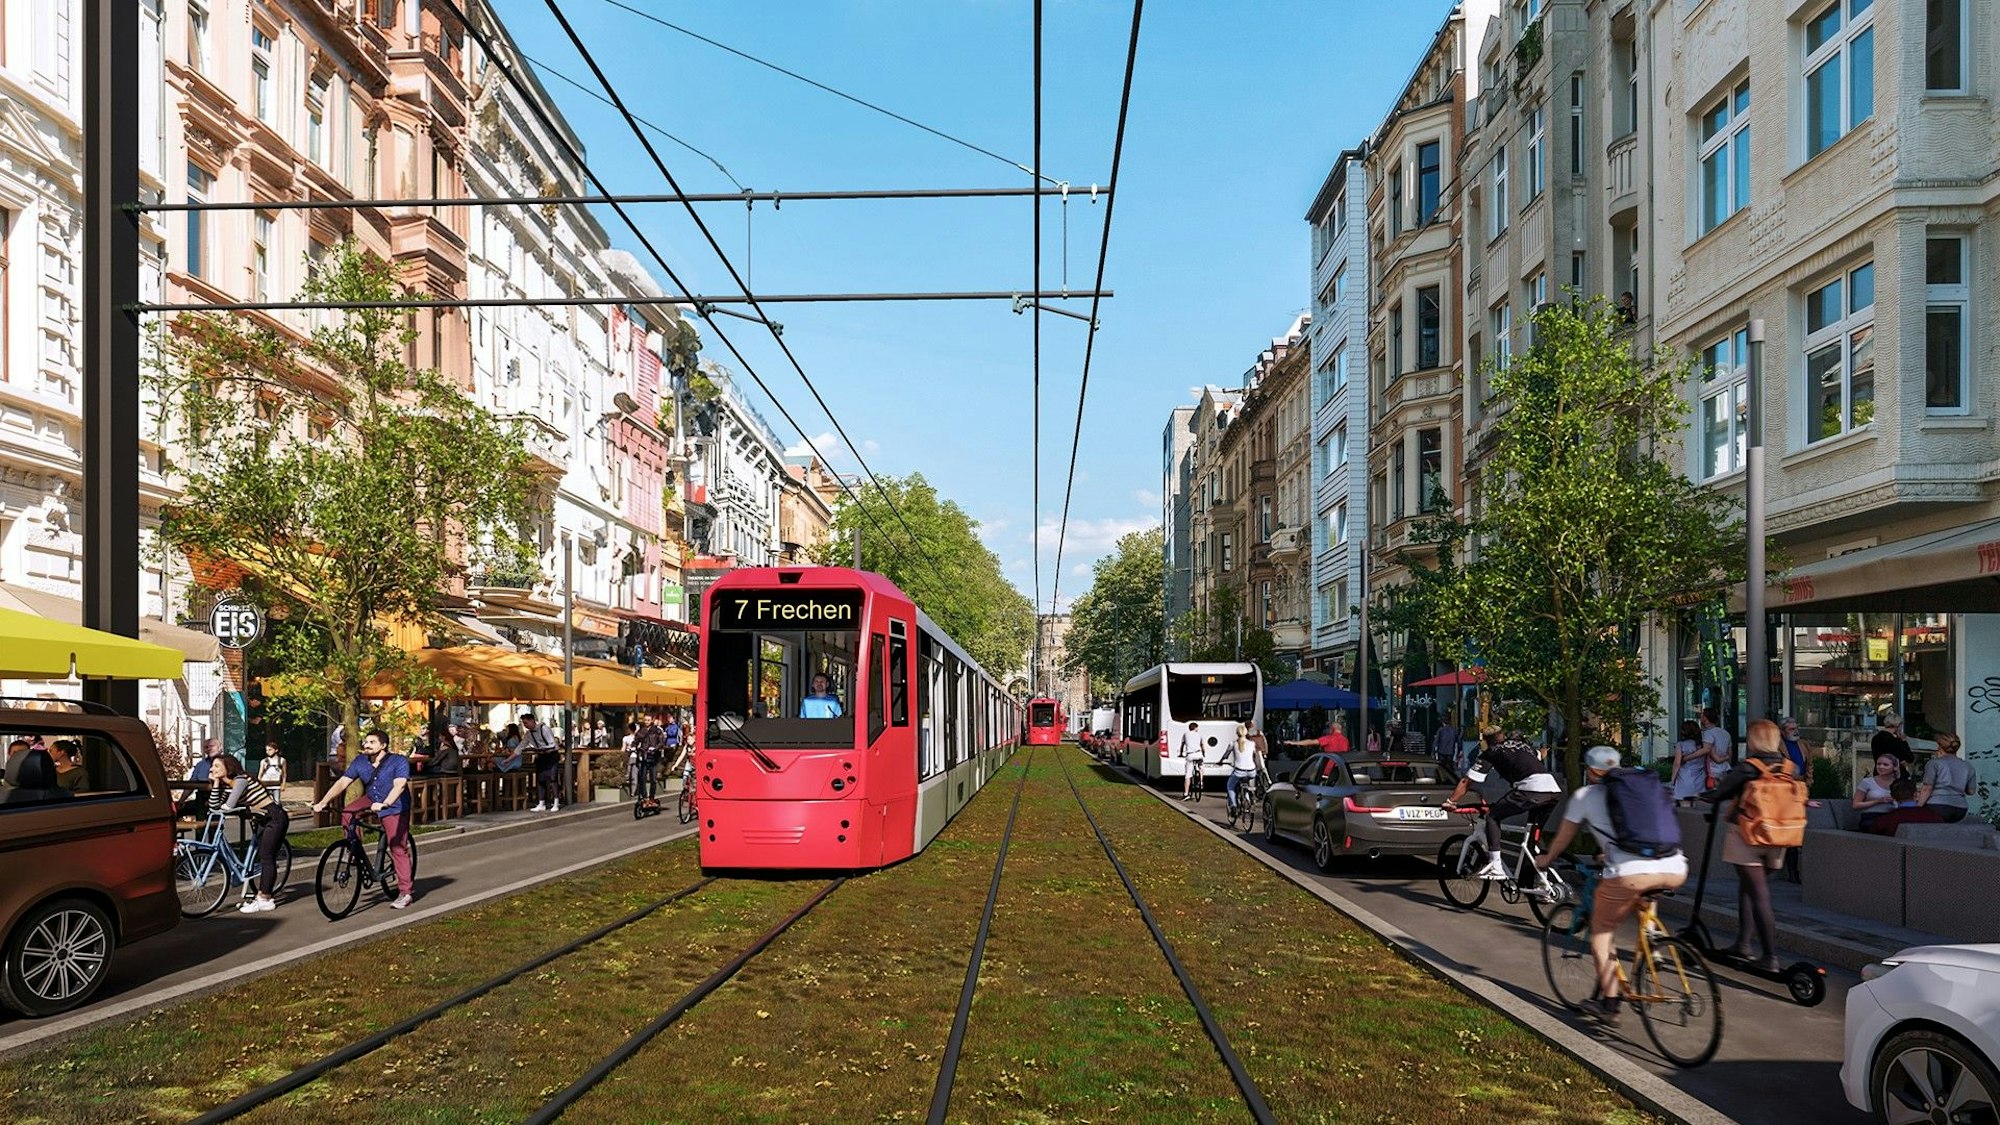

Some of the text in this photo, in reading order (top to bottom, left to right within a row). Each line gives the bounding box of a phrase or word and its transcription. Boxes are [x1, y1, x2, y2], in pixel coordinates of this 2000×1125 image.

[735, 599, 852, 620] 7 Frechen
[215, 611, 256, 638] EIS
[1405, 809, 1421, 818] VIZ
